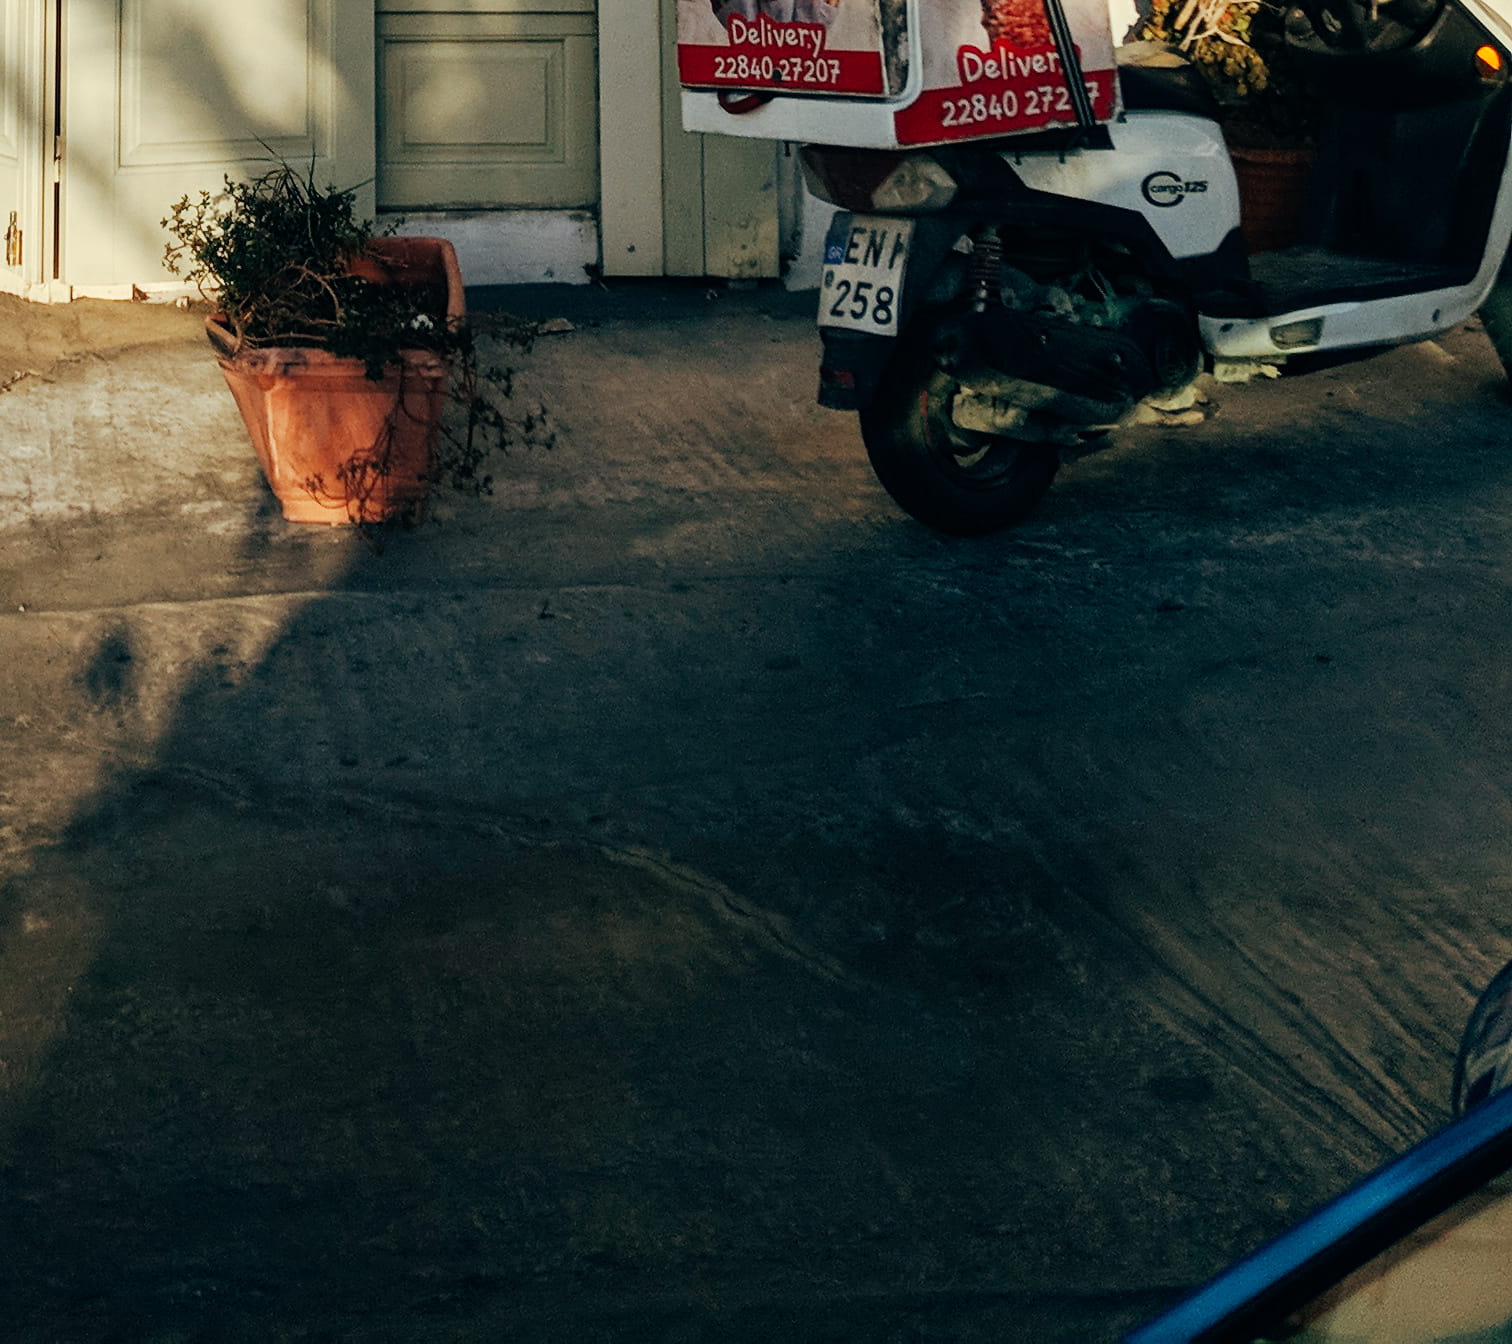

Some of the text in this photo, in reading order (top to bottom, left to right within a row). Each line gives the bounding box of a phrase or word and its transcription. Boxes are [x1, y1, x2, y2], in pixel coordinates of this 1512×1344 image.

[731, 18, 822, 58] Delivery
[714, 55, 840, 84] 22840 27207
[963, 45, 1067, 82] Deliver
[941, 81, 1100, 127] 22840 2727
[830, 279, 894, 325] 258
